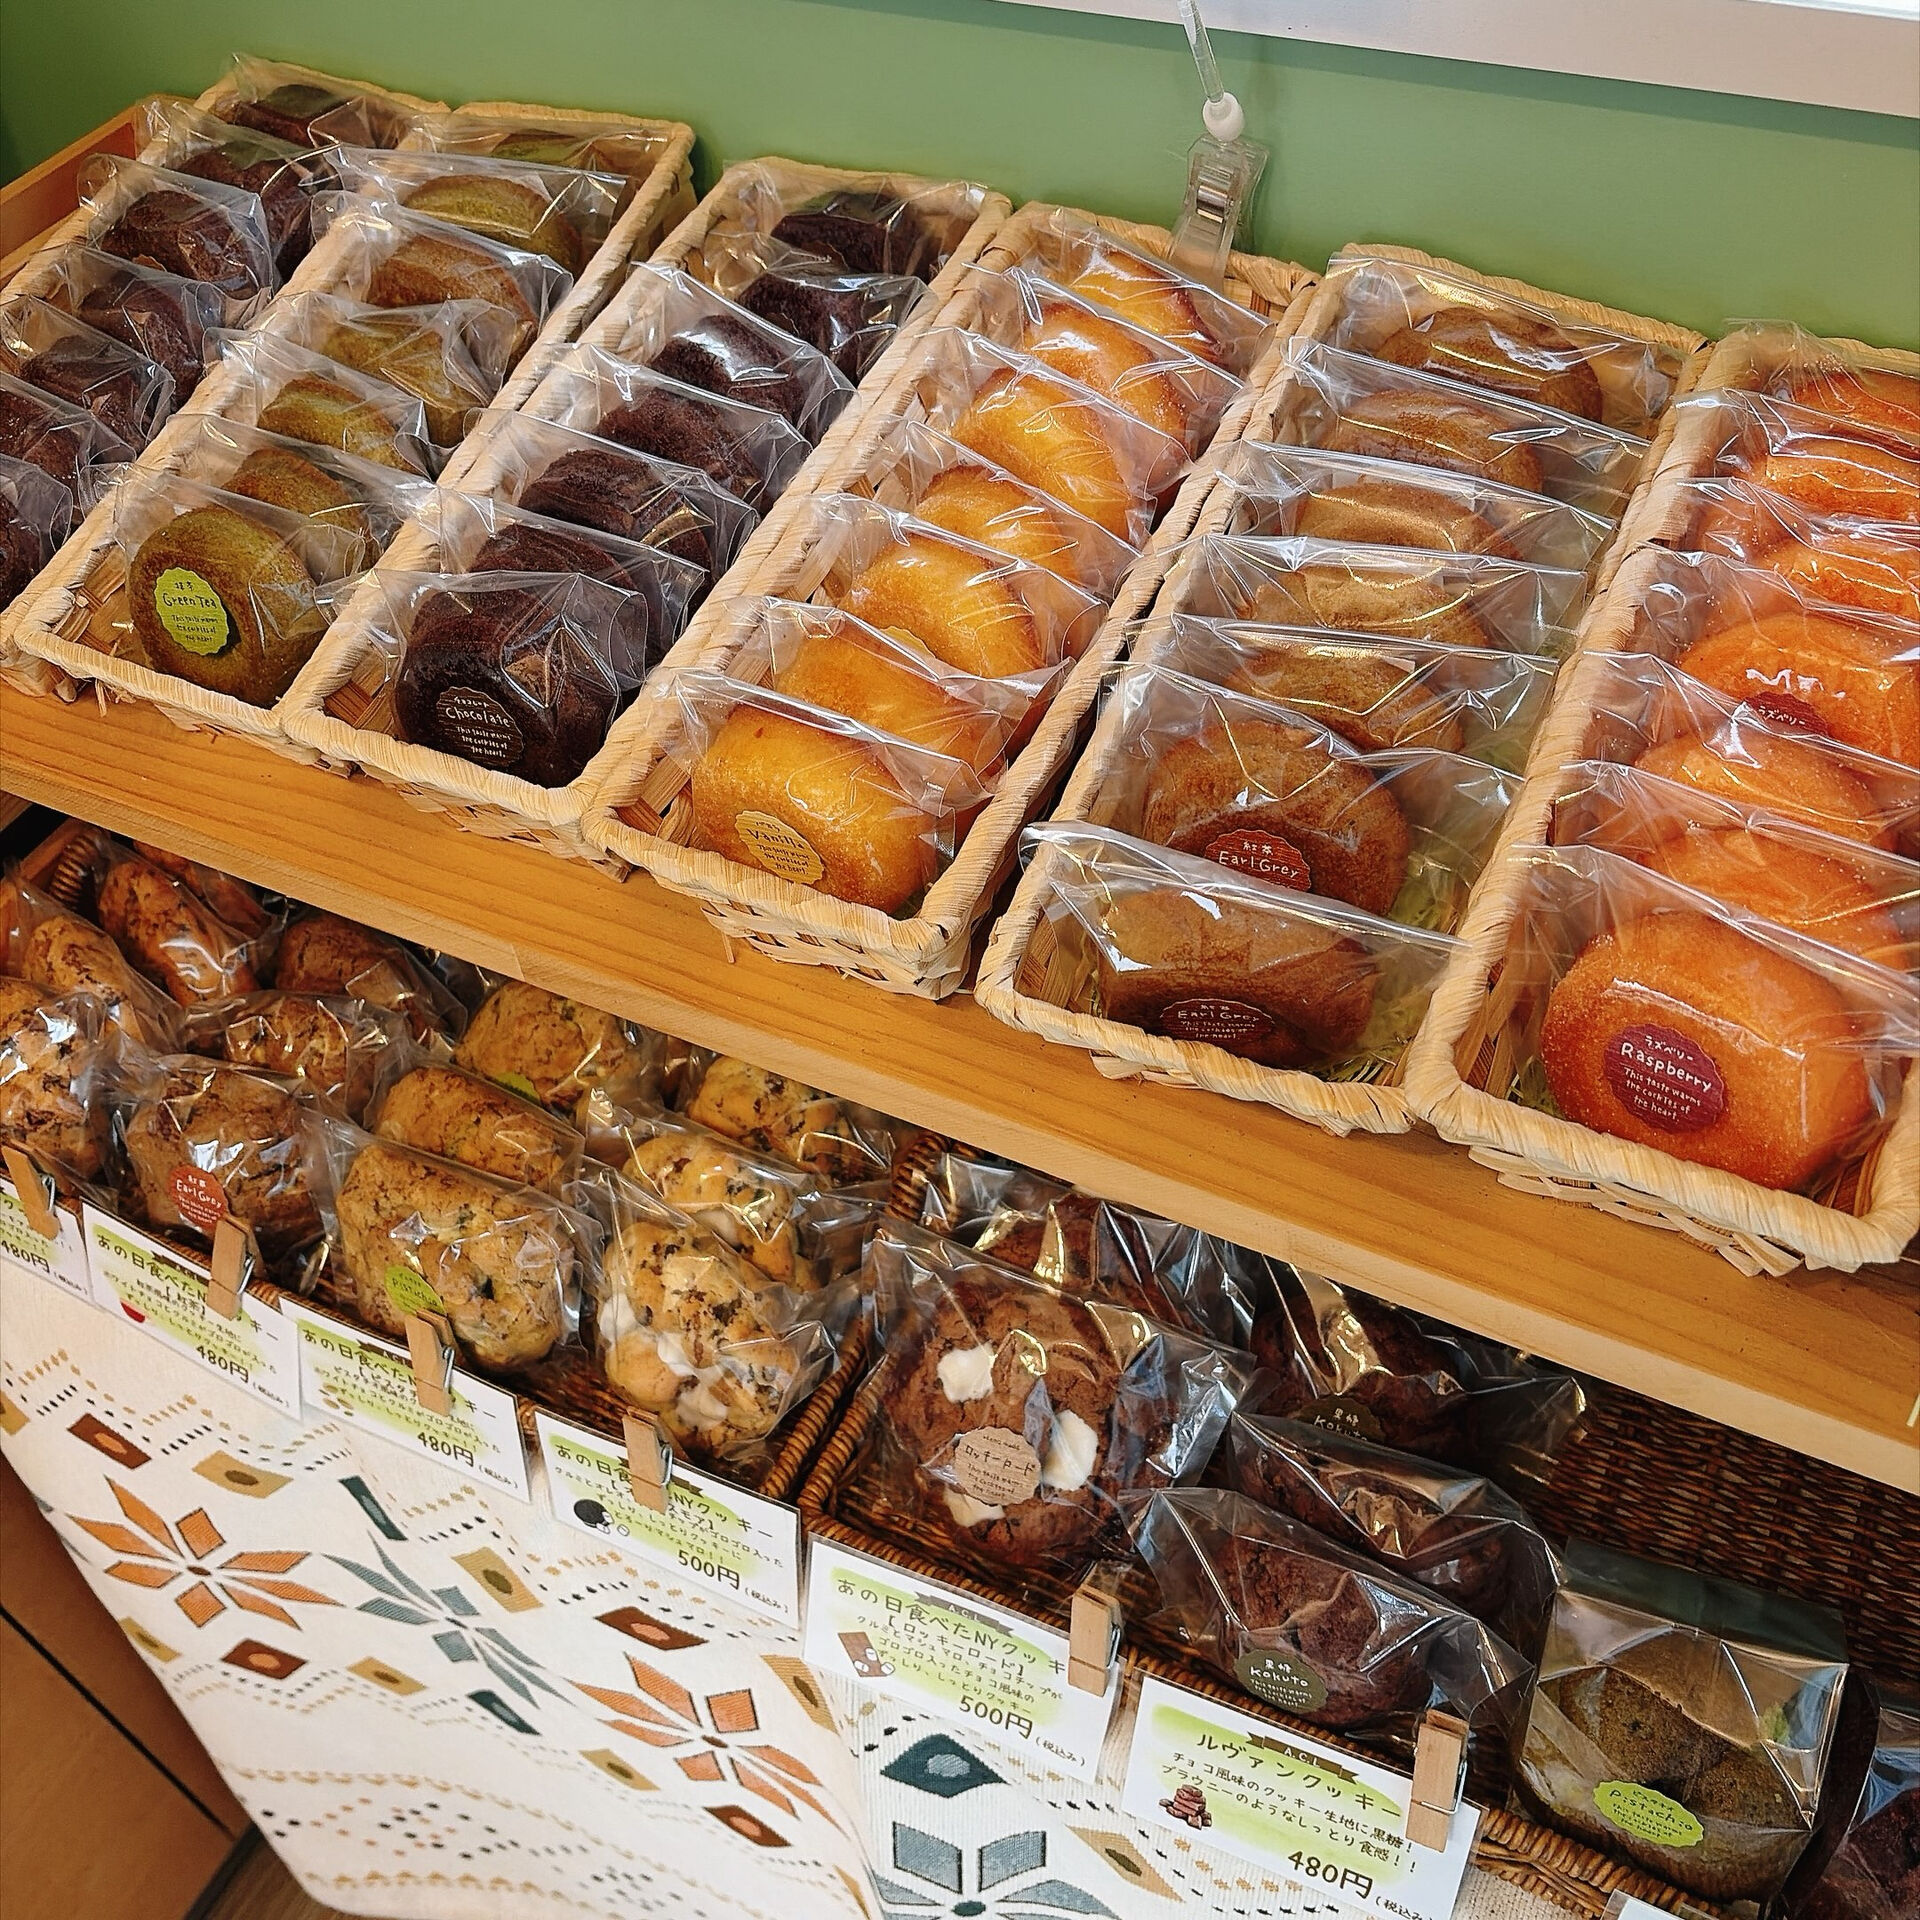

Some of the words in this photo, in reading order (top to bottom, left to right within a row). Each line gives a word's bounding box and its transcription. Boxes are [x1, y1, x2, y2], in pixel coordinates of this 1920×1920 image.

[163, 593, 196, 607] Green
[195, 595, 217, 608] Tea
[446, 707, 510, 727] Chocolate
[1758, 705, 1806, 725] ラズベリー
[746, 828, 805, 850] Vanilla
[1218, 851, 1254, 868] Earl
[1260, 859, 1299, 878] Grey
[1178, 1011, 1214, 1019] Earl
[1220, 1012, 1259, 1022] Grey
[1621, 1042, 1712, 1092] Raspberry
[1645, 1035, 1694, 1061] ラズベリー
[176, 1179, 196, 1197] Earl
[198, 1191, 222, 1208] Grey
[195, 1340, 248, 1384] 480円
[416, 1428, 474, 1468] 480円
[965, 1445, 1036, 1477] ロッキーロード
[555, 1443, 773, 1542] あの日食NYクッキー
[677, 1546, 739, 1591] 500円
[886, 1615, 1025, 1676] 【ロッキーロード】
[1250, 1666, 1309, 1687] Kokuto
[959, 1692, 1033, 1741] 500円
[1196, 1730, 1402, 1823] ルヴァンクッキー
[1160, 1763, 1417, 1873] ブラウニーのようなしっとり食感！！
[1610, 1789, 1693, 1831] Pistachio
[1286, 1846, 1374, 1901] 480円
